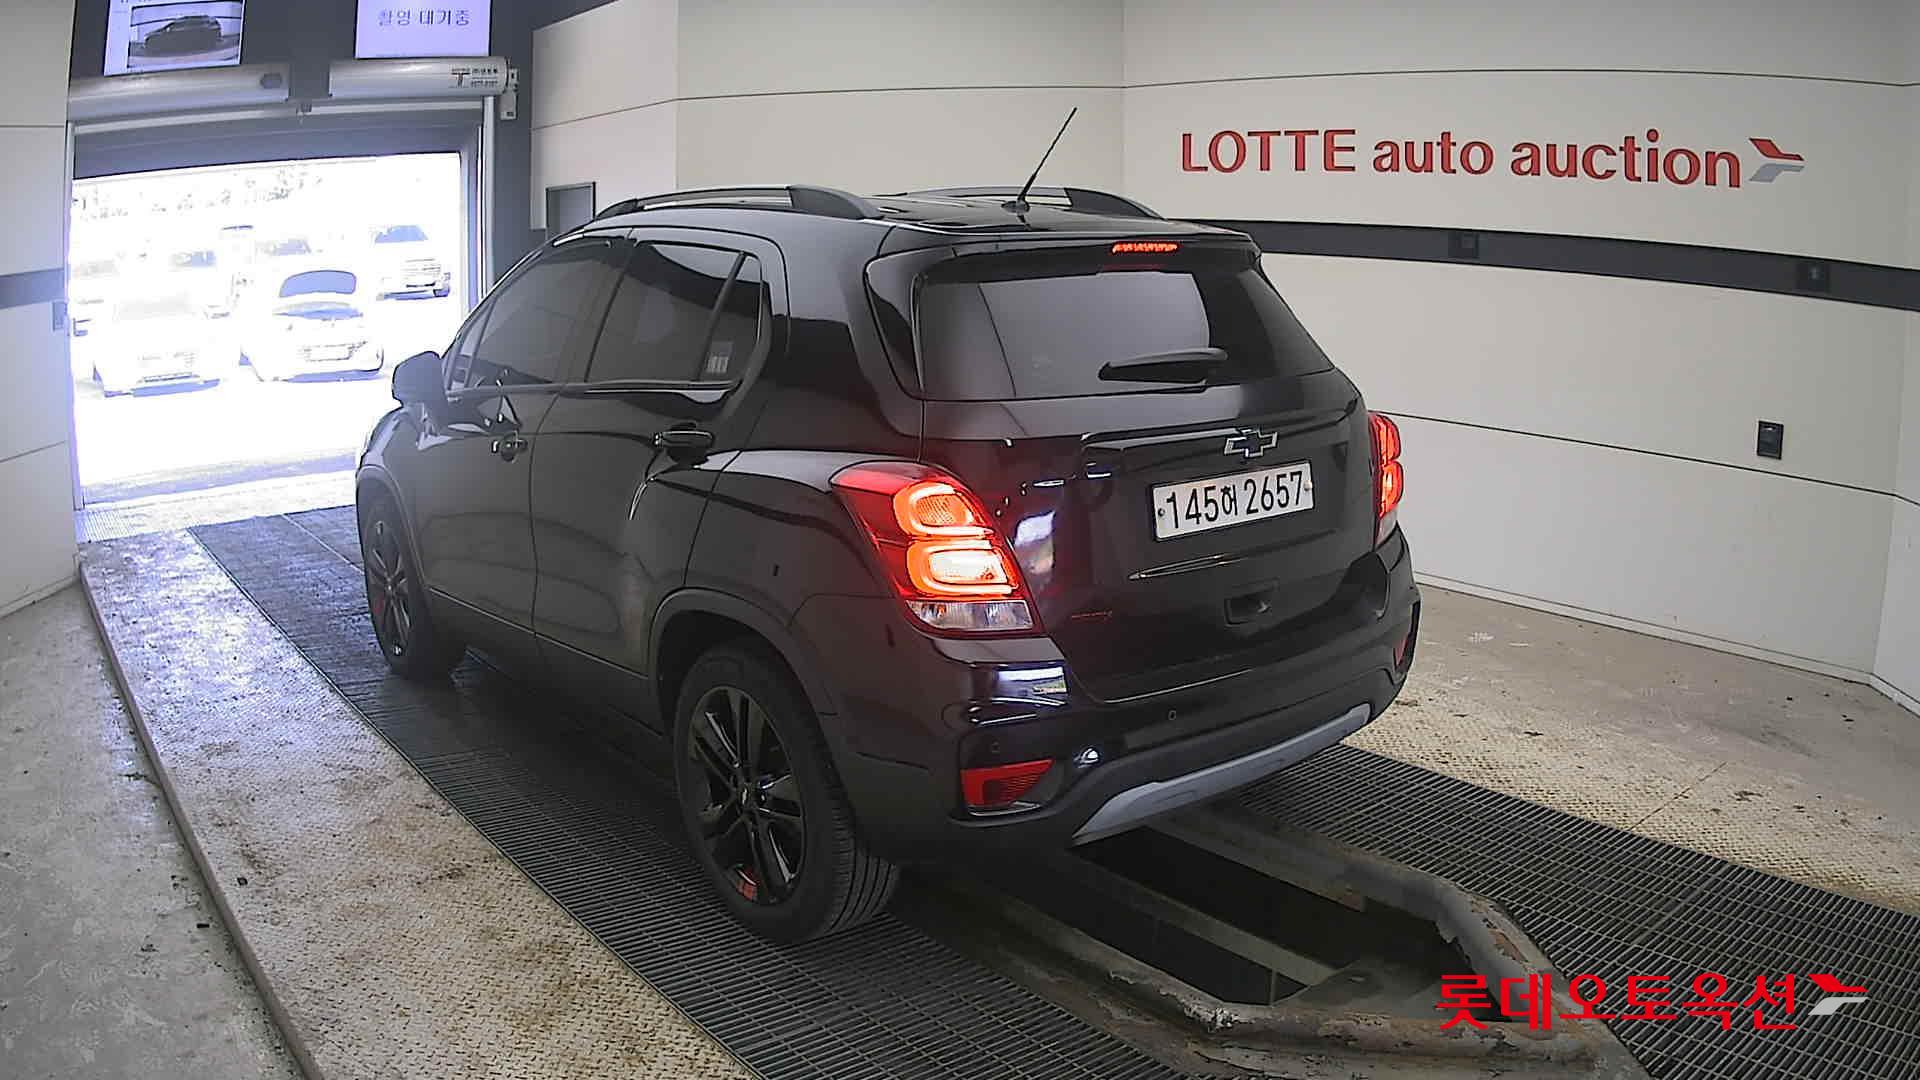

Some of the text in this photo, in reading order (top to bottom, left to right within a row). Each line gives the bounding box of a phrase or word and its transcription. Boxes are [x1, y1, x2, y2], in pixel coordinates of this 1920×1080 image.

[418, 9, 470, 26] 대기중
[1181, 128, 1741, 188] LOTTE auto auction
[1166, 470, 1303, 529] 145허 2657
